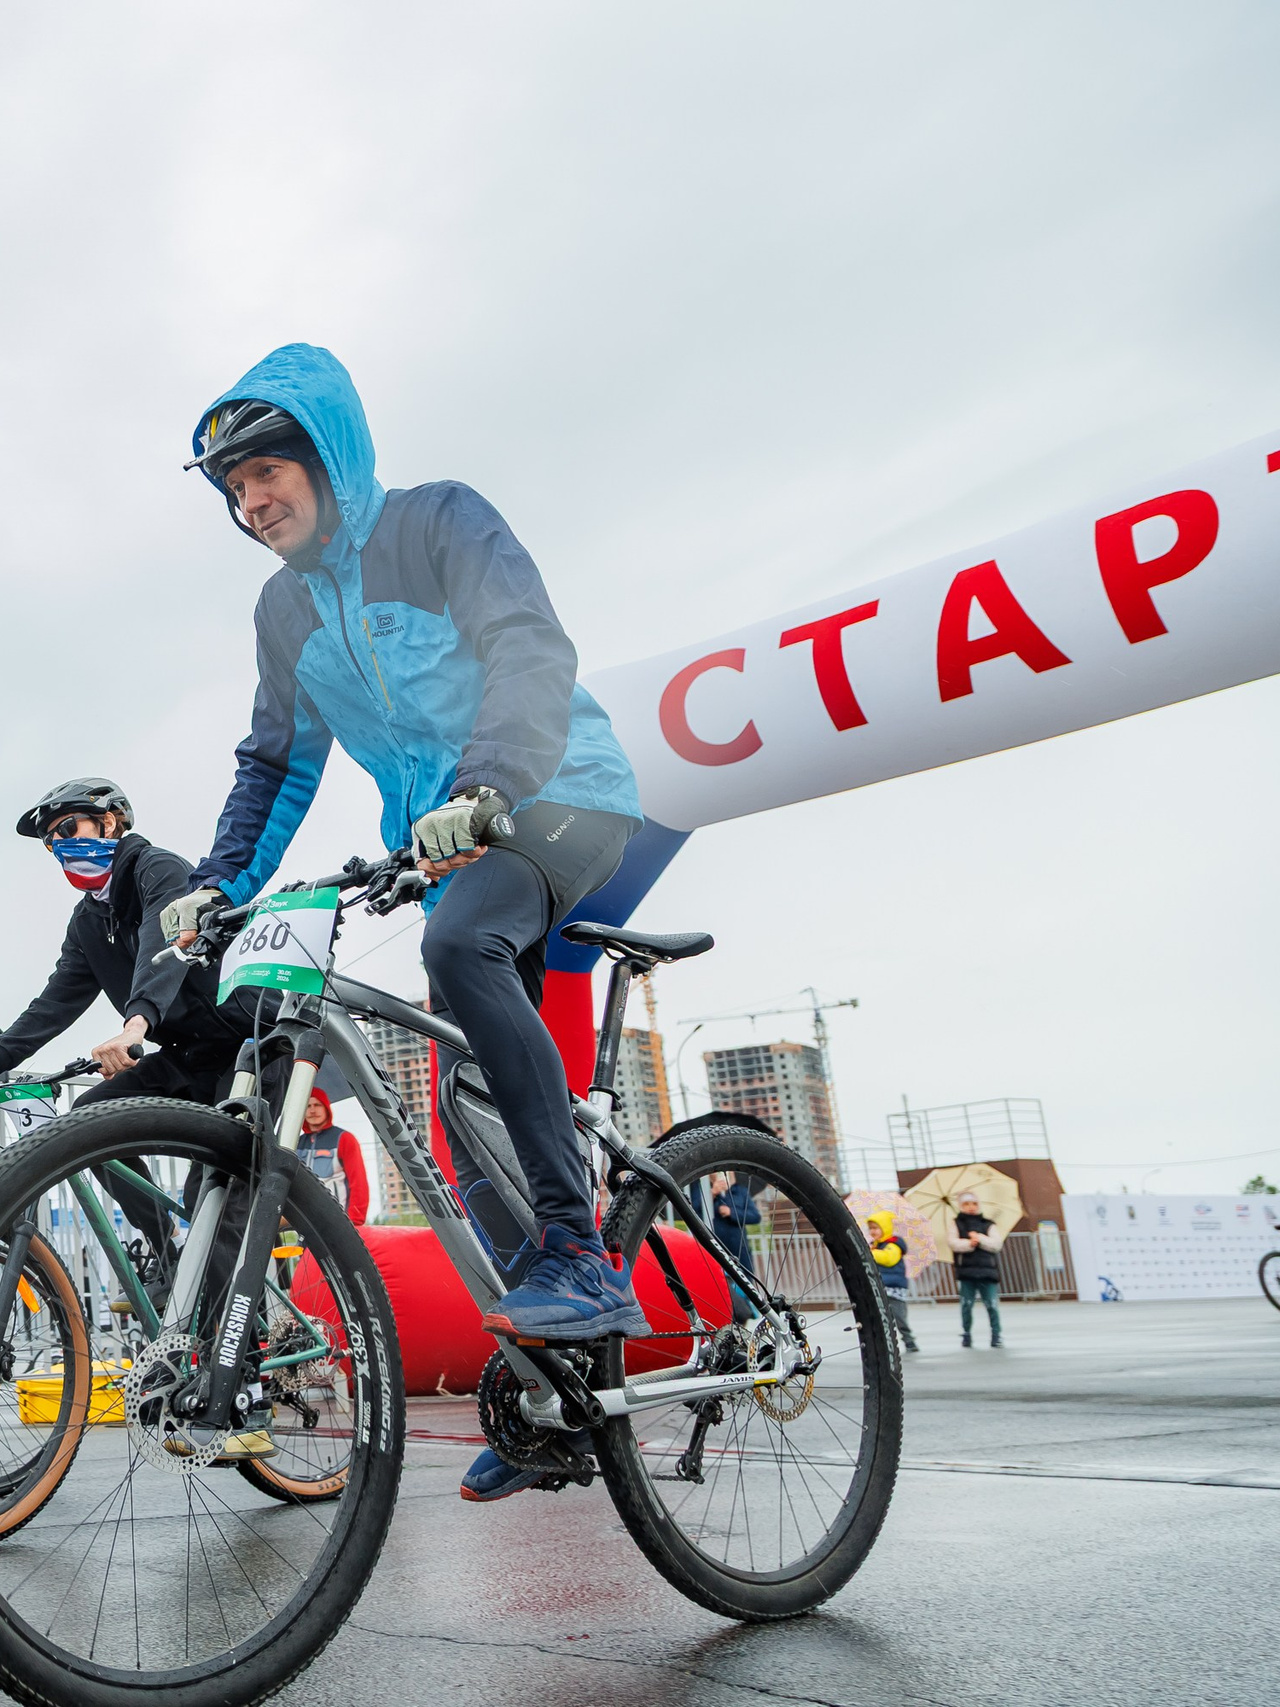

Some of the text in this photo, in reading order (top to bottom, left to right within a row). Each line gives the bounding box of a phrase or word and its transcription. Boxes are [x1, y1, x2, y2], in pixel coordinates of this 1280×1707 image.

[658, 450, 1280, 766] СТАР
[239, 922, 291, 956] 860
[361, 1083, 452, 1219] JAMIS
[710, 1238, 763, 1301] DAKOTA
[219, 1293, 252, 1368] ROCKSHOX
[721, 1376, 755, 1384] JAMIS
